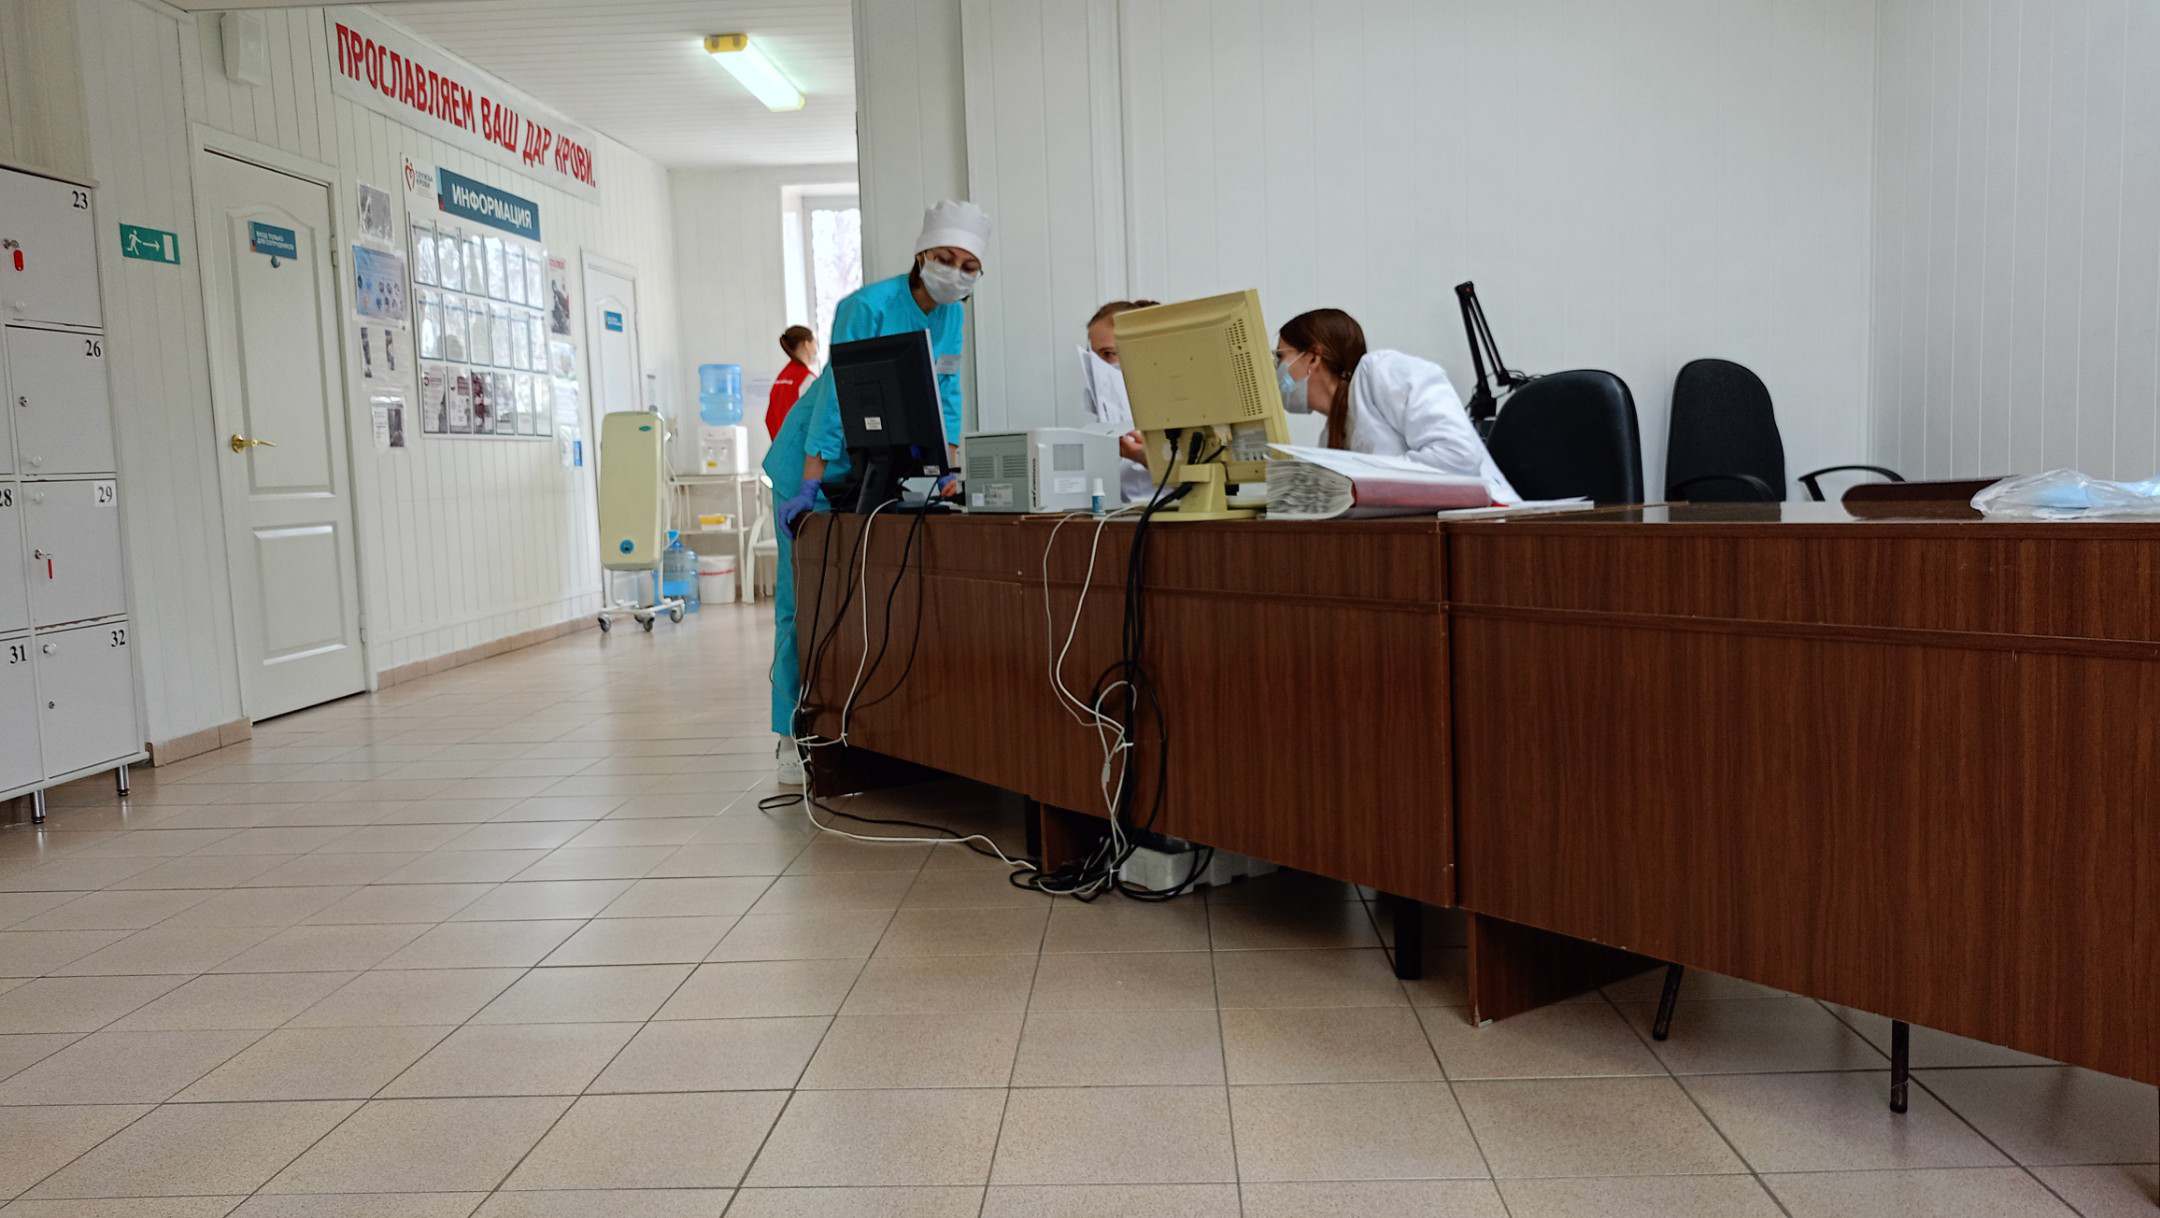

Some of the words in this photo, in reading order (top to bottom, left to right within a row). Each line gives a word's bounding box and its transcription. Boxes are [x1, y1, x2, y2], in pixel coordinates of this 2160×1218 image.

[335, 22, 477, 133] ПРОСЛАВЛЯЕМ
[481, 97, 519, 153] ВАШ
[522, 120, 552, 169] ДАР
[554, 134, 596, 188] КРОВИ.
[71, 190, 88, 209] 23
[452, 184, 532, 230] ИНФОРМАЦИЯ
[85, 339, 102, 358] 26
[0, 488, 13, 507] 8
[98, 486, 113, 503] 29
[110, 629, 126, 647] 32
[9, 644, 27, 664] 31
